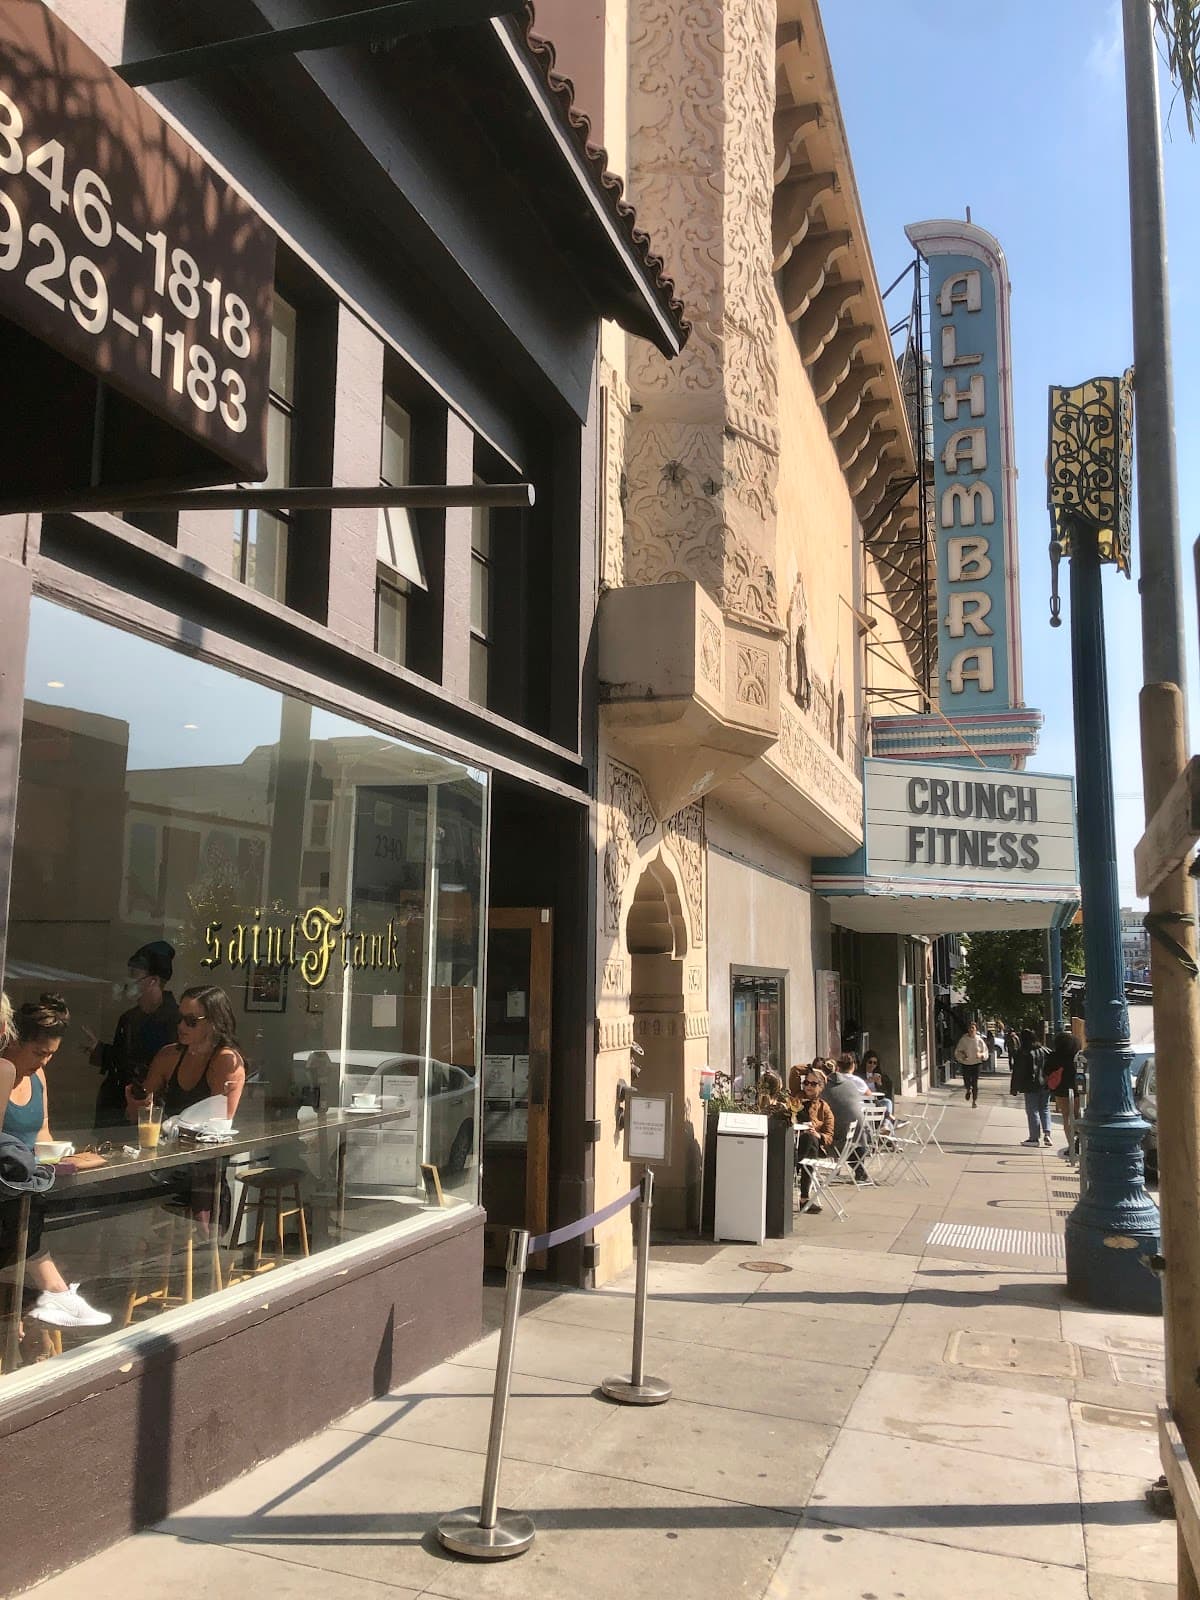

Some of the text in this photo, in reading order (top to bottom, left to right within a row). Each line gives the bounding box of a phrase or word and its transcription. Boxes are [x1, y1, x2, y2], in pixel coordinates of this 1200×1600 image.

[936, 270, 995, 694] ALHAMBRA
[908, 777, 1038, 823] CRUNCH
[908, 826, 1040, 871] FITNESS
[301, 905, 401, 987] Frank
